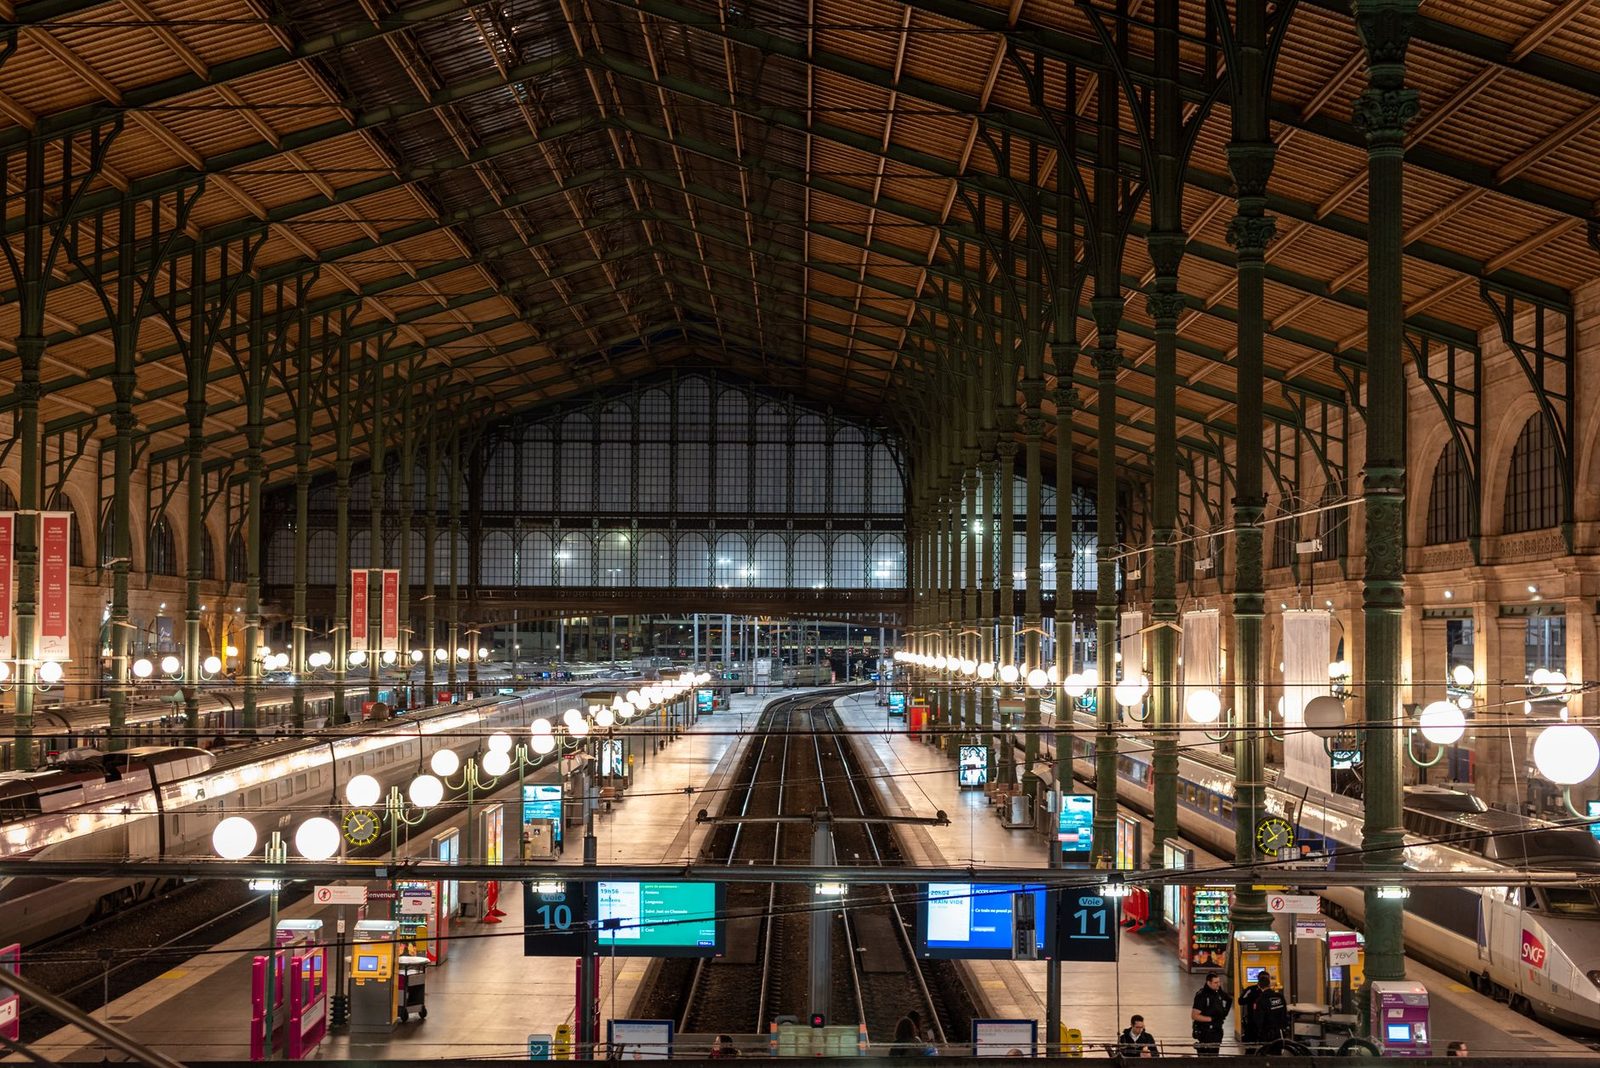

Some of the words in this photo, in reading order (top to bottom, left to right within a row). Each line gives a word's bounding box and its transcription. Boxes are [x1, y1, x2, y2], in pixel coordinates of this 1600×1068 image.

[536, 905, 571, 929] 10
[1073, 909, 1106, 934] 11
[1522, 943, 1544, 963] SNCF
